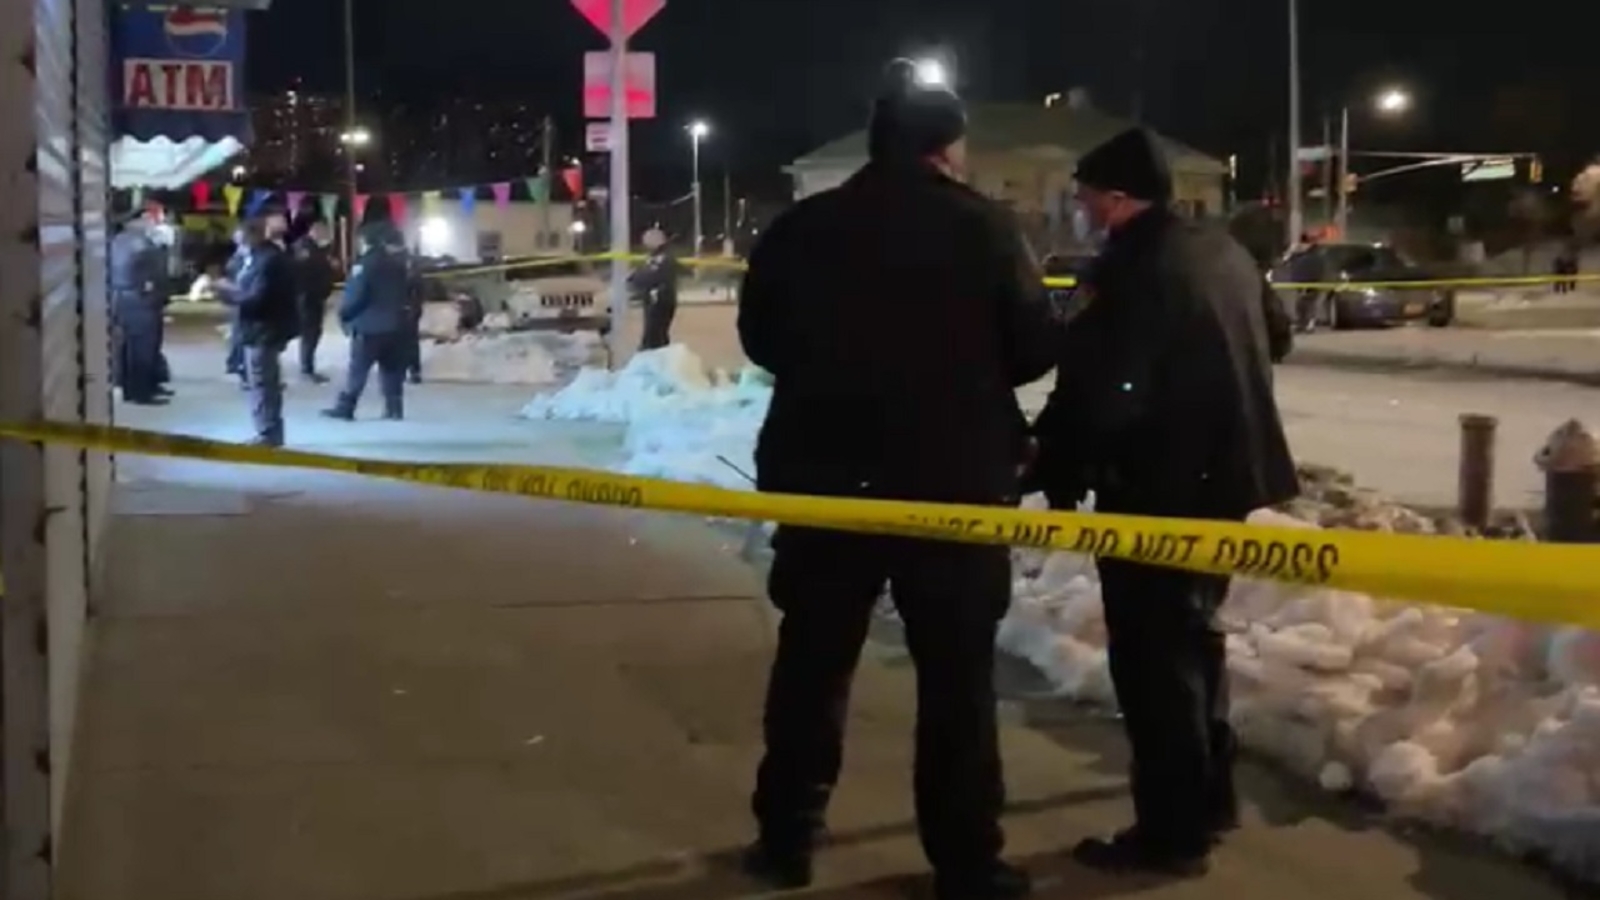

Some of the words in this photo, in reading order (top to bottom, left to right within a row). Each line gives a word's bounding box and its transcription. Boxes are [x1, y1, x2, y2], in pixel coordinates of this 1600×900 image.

[129, 63, 227, 106] ATM
[1129, 530, 1202, 563] NOT
[1212, 535, 1339, 582] CROSS
